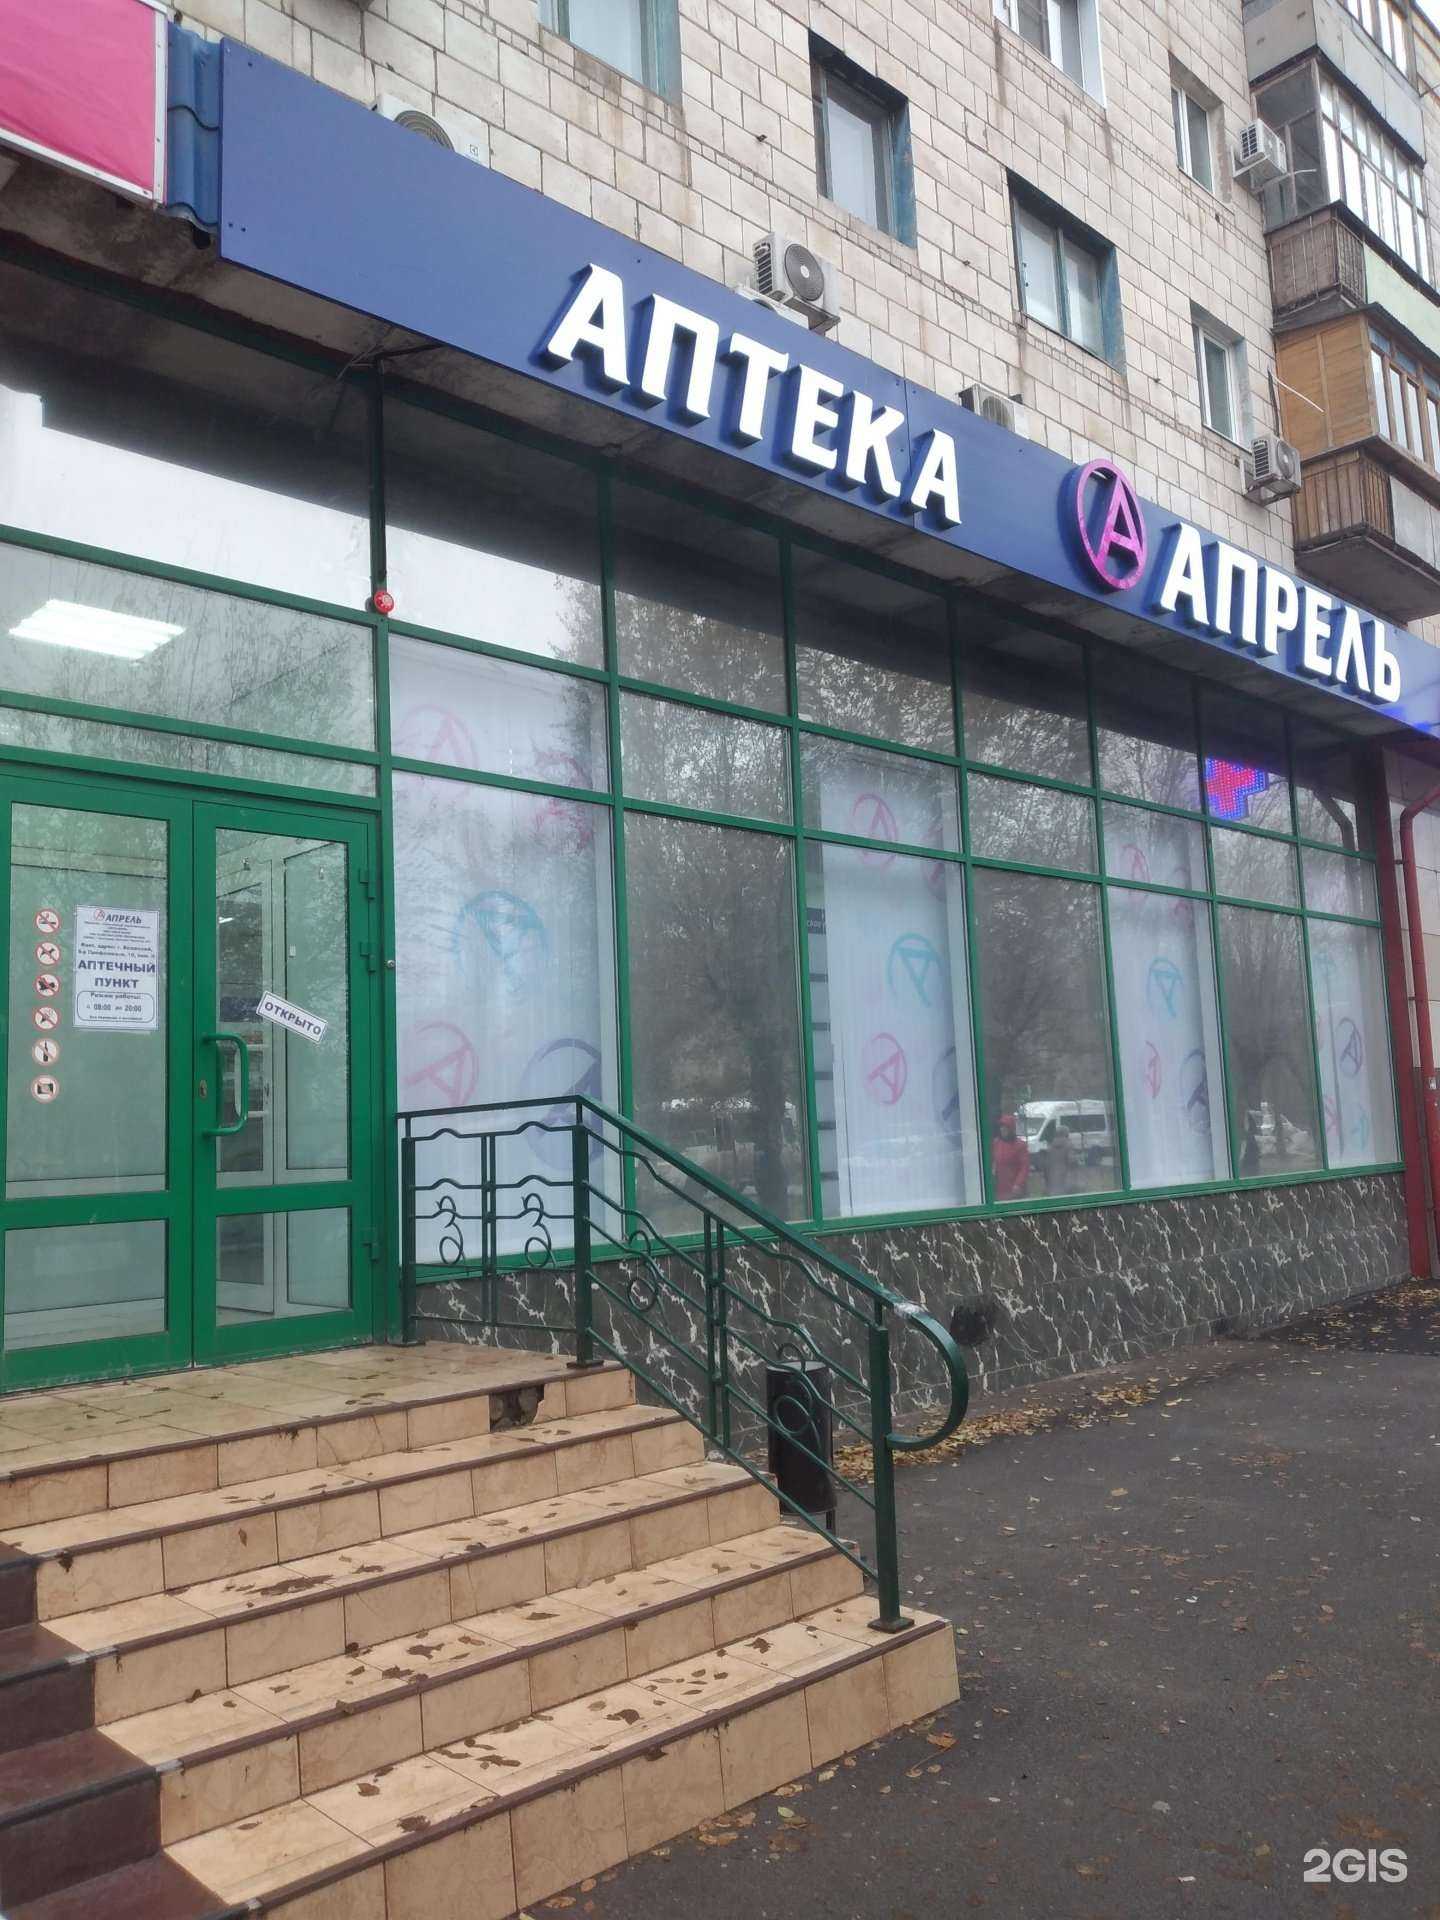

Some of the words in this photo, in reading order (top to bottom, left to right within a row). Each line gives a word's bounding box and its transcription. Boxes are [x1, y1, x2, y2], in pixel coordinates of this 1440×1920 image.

[546, 262, 962, 525] АПТЕКА
[1159, 522, 1401, 703] АПРЕЛЬ
[105, 914, 142, 924] АПРЕЛЬ
[78, 960, 156, 973] АПТЕЧНЫЙ
[95, 977, 140, 989] ПУНКТ
[265, 1002, 321, 1035] ОТКРЫТО
